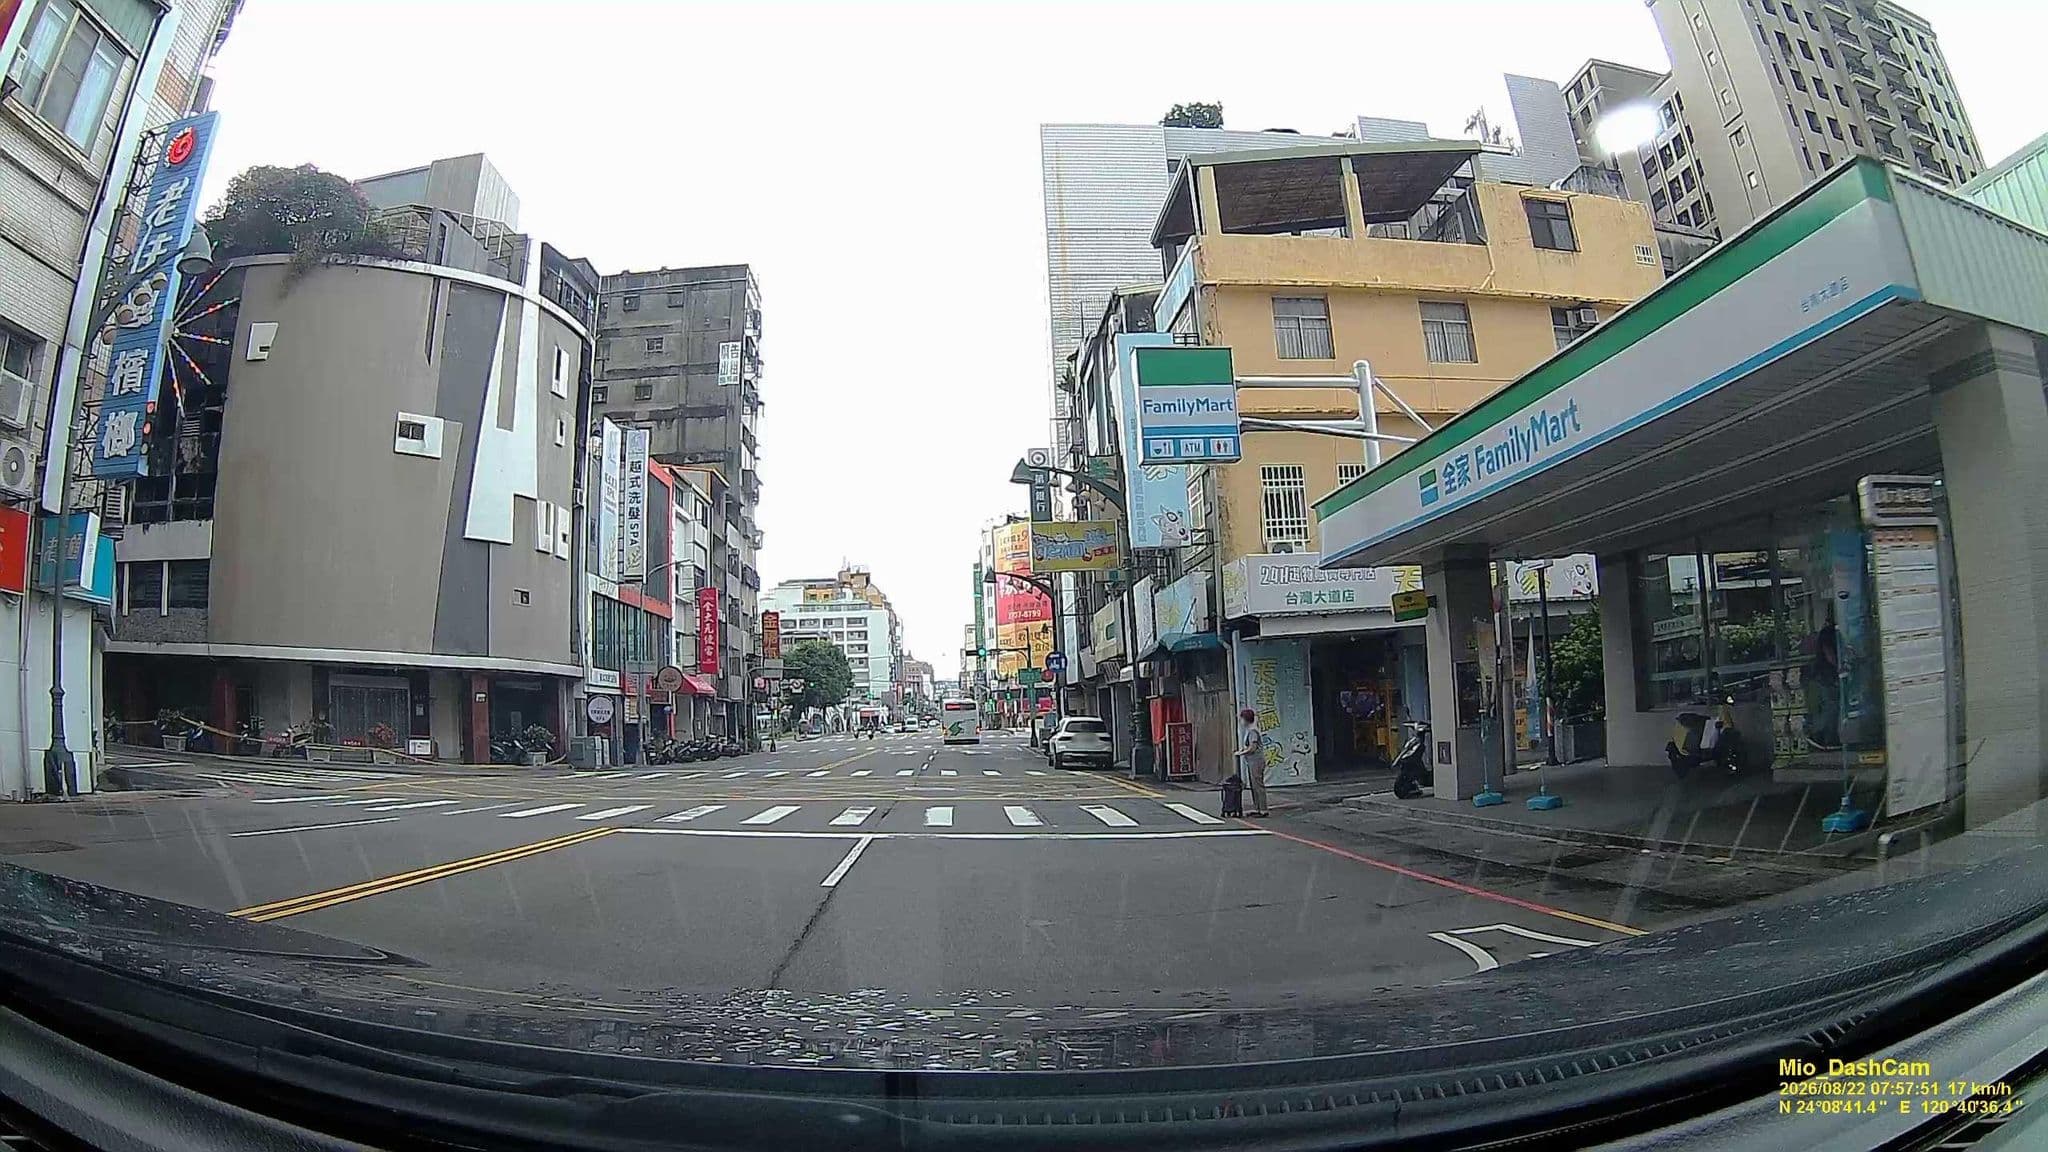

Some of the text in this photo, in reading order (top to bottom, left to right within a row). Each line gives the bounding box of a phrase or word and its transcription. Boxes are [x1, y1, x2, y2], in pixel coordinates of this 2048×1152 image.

[1143, 398, 1233, 416] FamilyMart
[1184, 442, 1201, 454] ATM
[1442, 397, 1581, 495] 全家 FamilyMart
[1286, 589, 1355, 606] 台灣大道店
